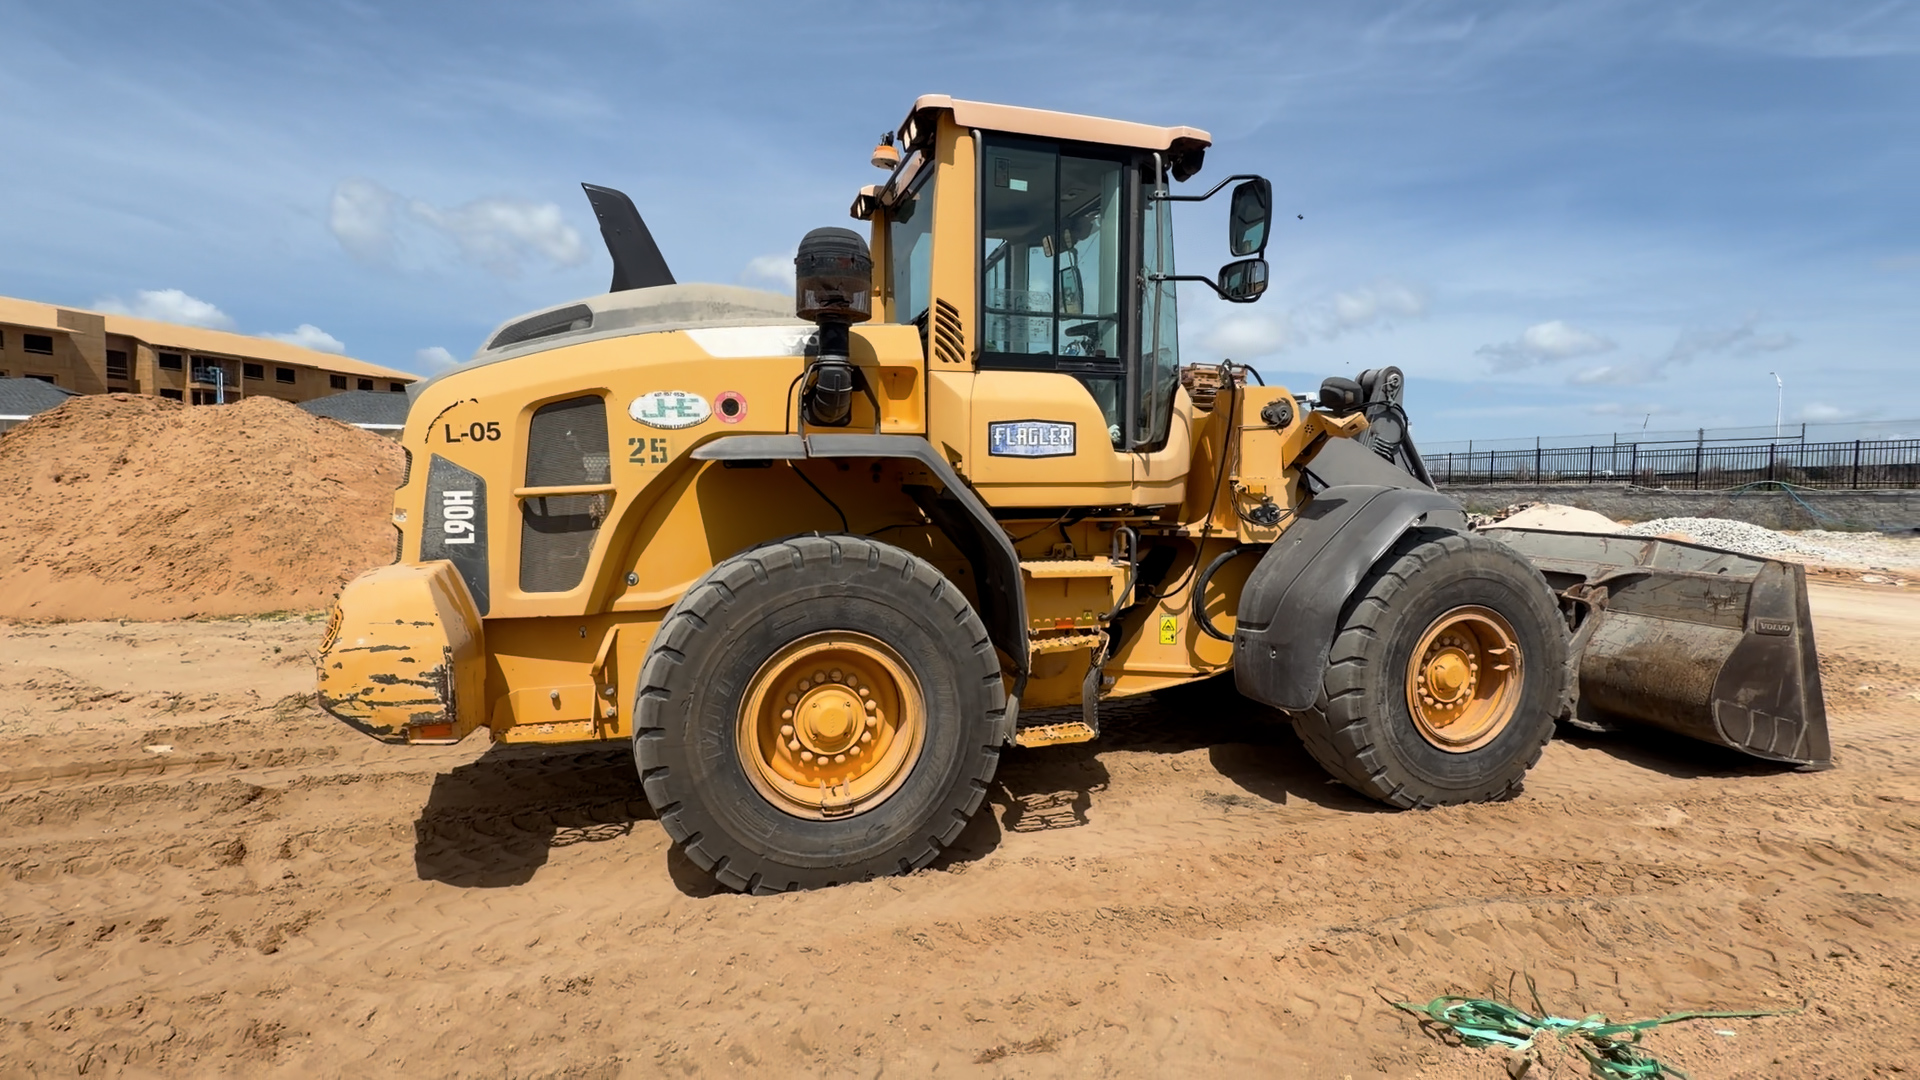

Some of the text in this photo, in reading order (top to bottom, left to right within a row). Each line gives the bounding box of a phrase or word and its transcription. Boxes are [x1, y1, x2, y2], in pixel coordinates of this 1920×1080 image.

[445, 421, 501, 443] L-05
[993, 427, 1071, 446] FLAGLER
[628, 437, 668, 464] 25
[442, 490, 475, 545] L90H
[1760, 622, 1791, 632] VOLVO
